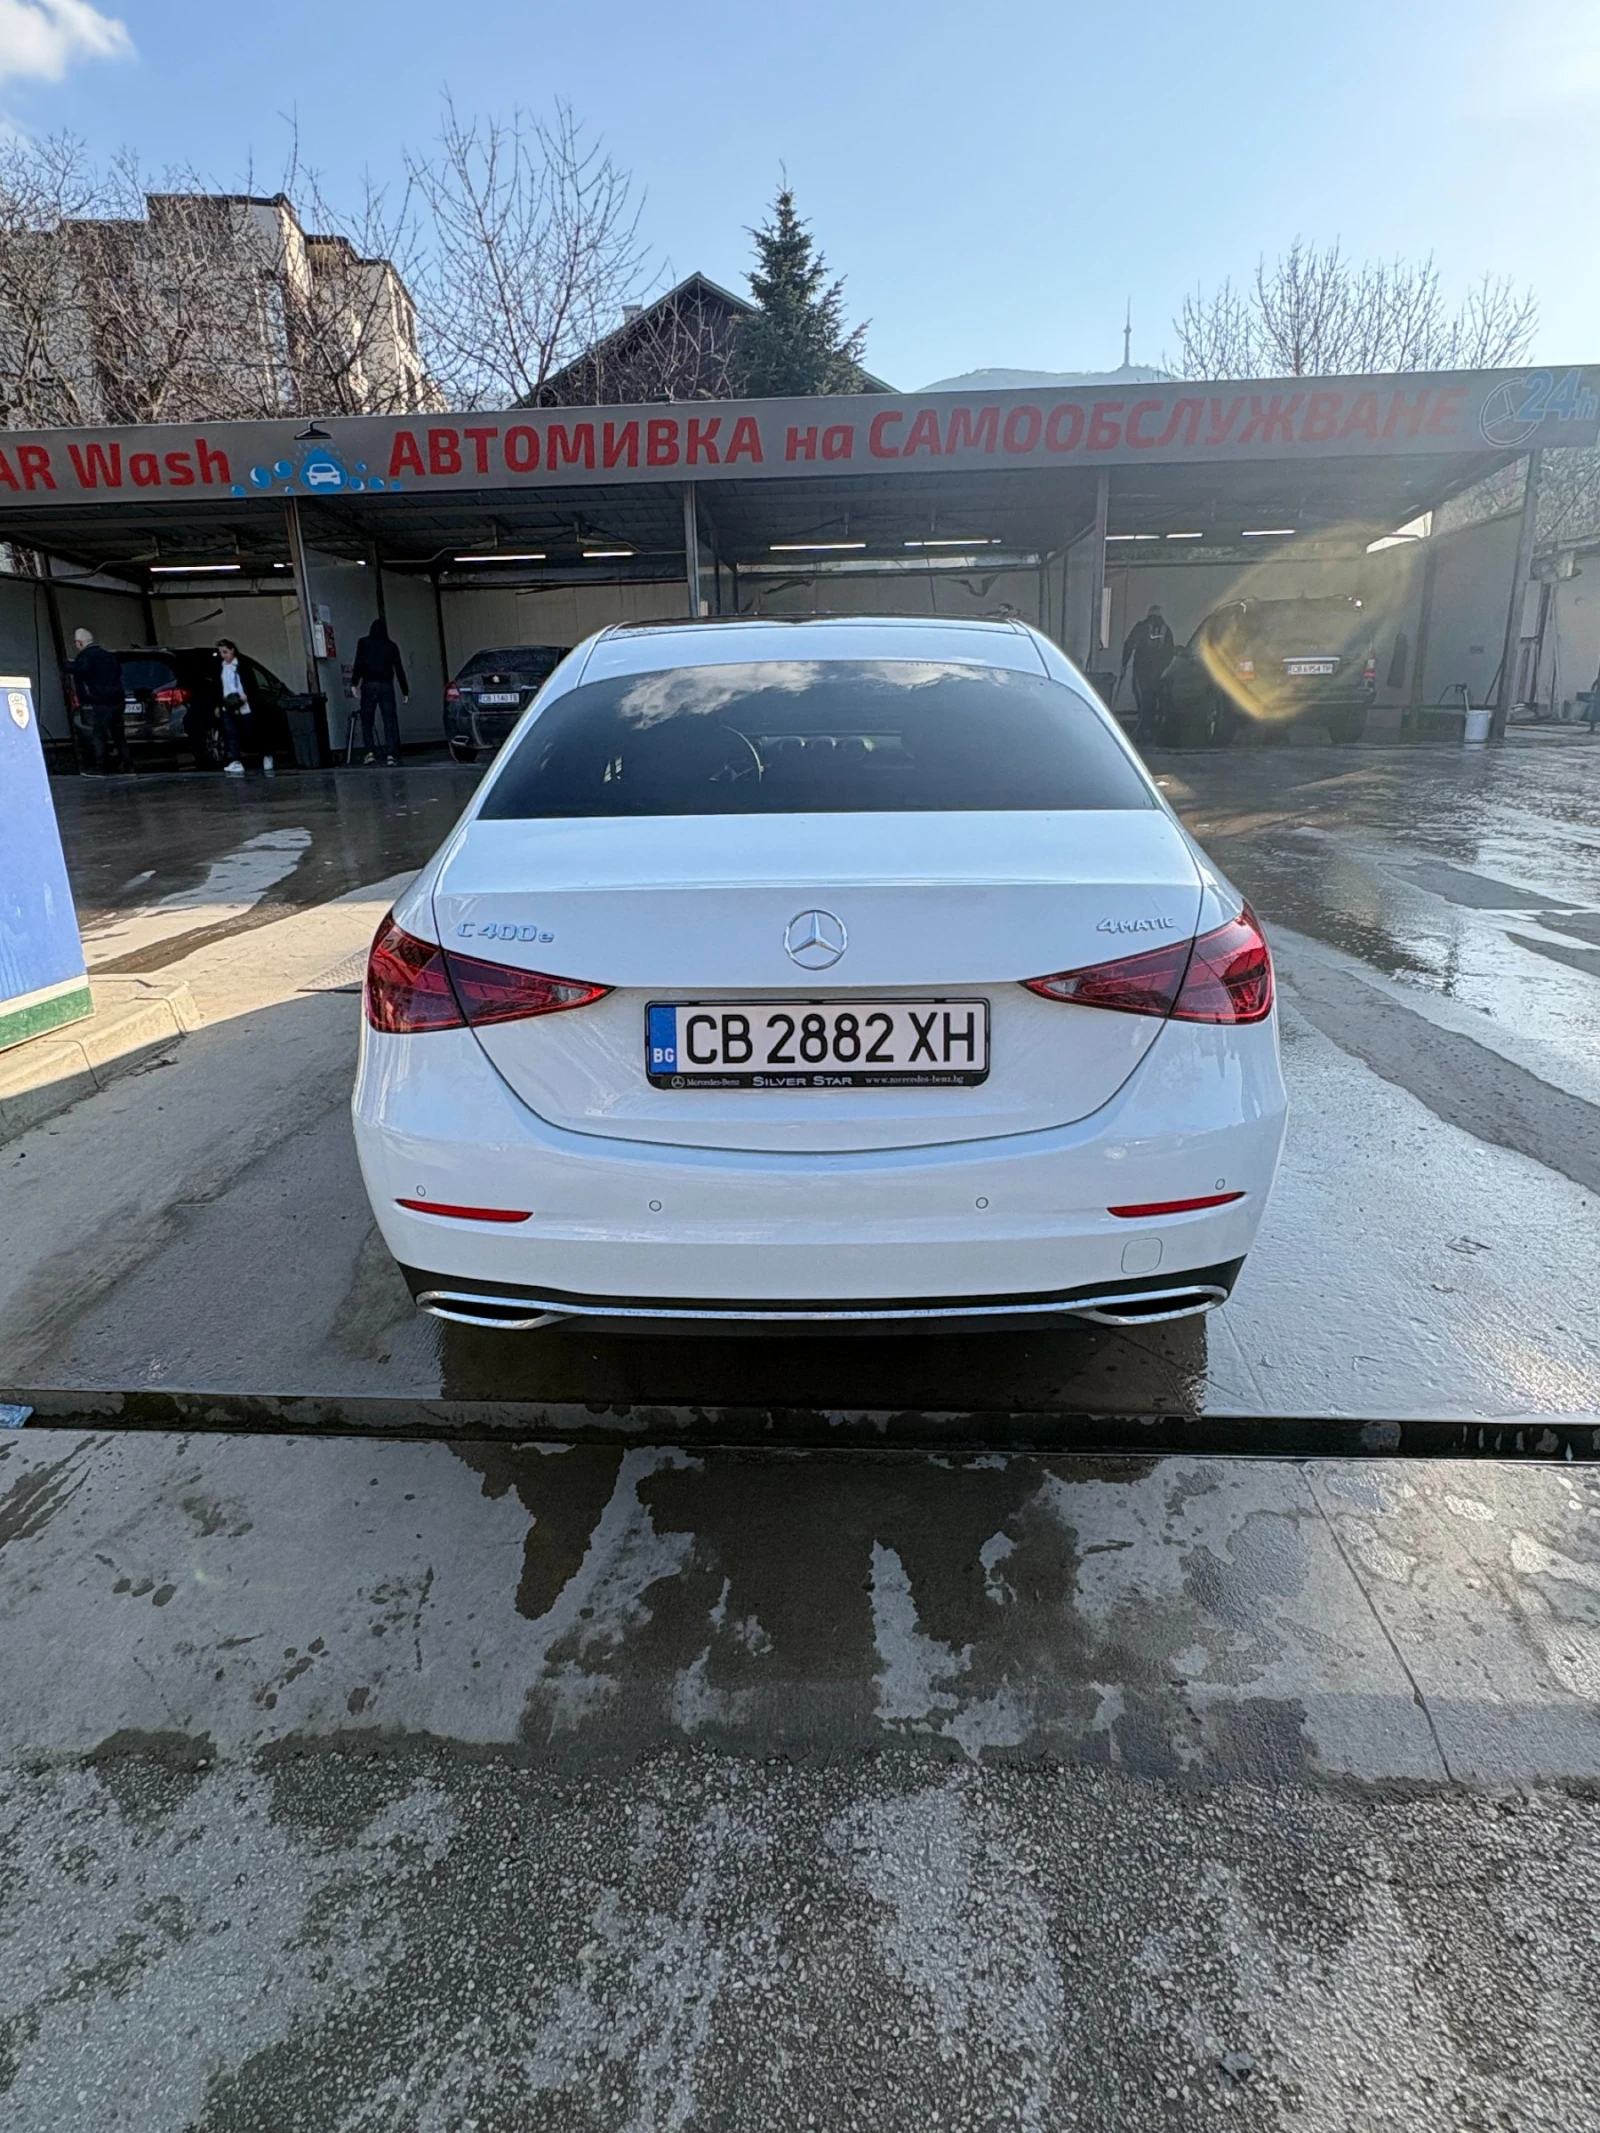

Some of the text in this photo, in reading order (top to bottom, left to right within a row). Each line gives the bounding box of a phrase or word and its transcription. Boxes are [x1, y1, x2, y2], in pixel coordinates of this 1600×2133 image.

[1513, 367, 1599, 422] 24h
[388, 386, 1470, 477] АВТОМИВКА на САМООБСЛУЖВАНЕ
[67, 438, 232, 489] Wash
[1096, 916, 1176, 935] 4MATIC
[653, 1047, 675, 1063] BG
[686, 1012, 975, 1065] CB 2882 XH
